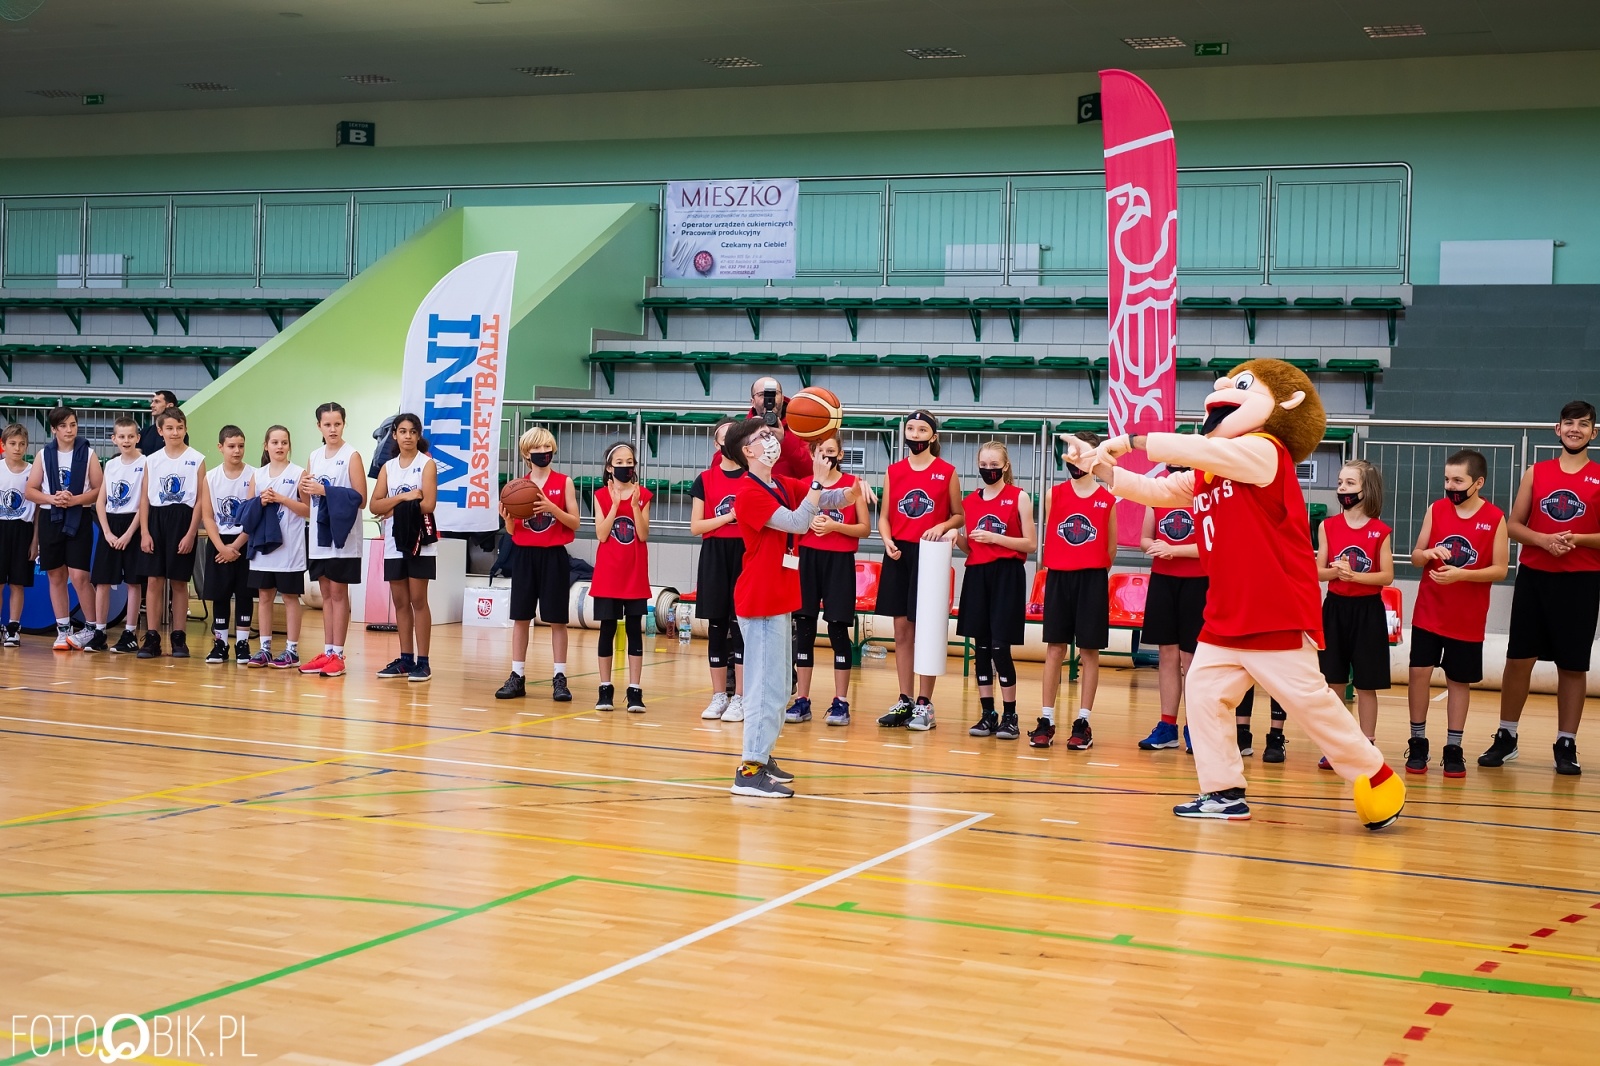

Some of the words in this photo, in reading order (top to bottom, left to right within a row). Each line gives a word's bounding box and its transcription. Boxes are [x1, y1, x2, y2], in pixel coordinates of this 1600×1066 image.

[1080, 103, 1093, 119] C
[349, 129, 367, 143] B
[681, 185, 782, 208] MIESZKO
[681, 221, 713, 229] Operator
[714, 220, 745, 229] urządzeń
[746, 220, 794, 228] cukierniczych
[718, 229, 761, 237] produkcyjny
[720, 241, 751, 249] Czekamy
[423, 313, 481, 509] MINI
[467, 314, 500, 509] BASKETBALL
